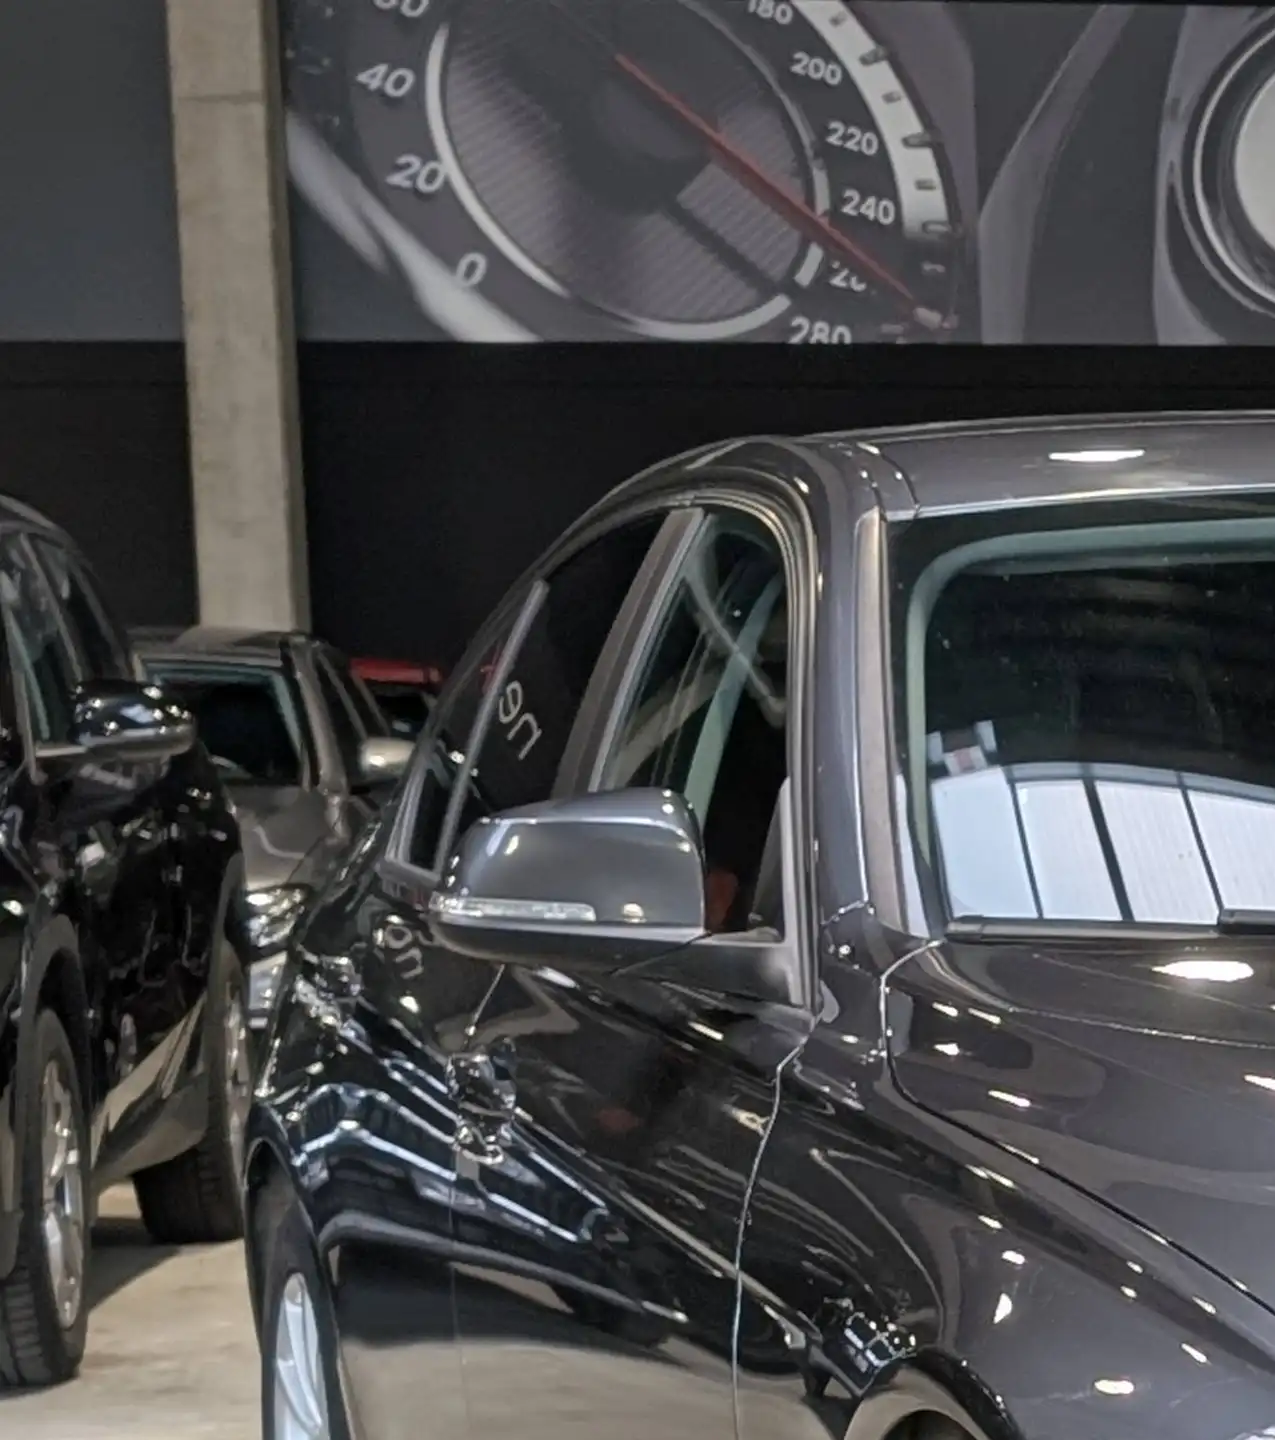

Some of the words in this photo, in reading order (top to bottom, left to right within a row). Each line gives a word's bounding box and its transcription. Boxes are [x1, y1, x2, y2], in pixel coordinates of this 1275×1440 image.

[357, 61, 414, 97] 40
[790, 51, 842, 85] 200
[827, 121, 879, 154] 220
[386, 155, 445, 193] 20
[841, 189, 895, 225] 240
[455, 252, 486, 288] 0
